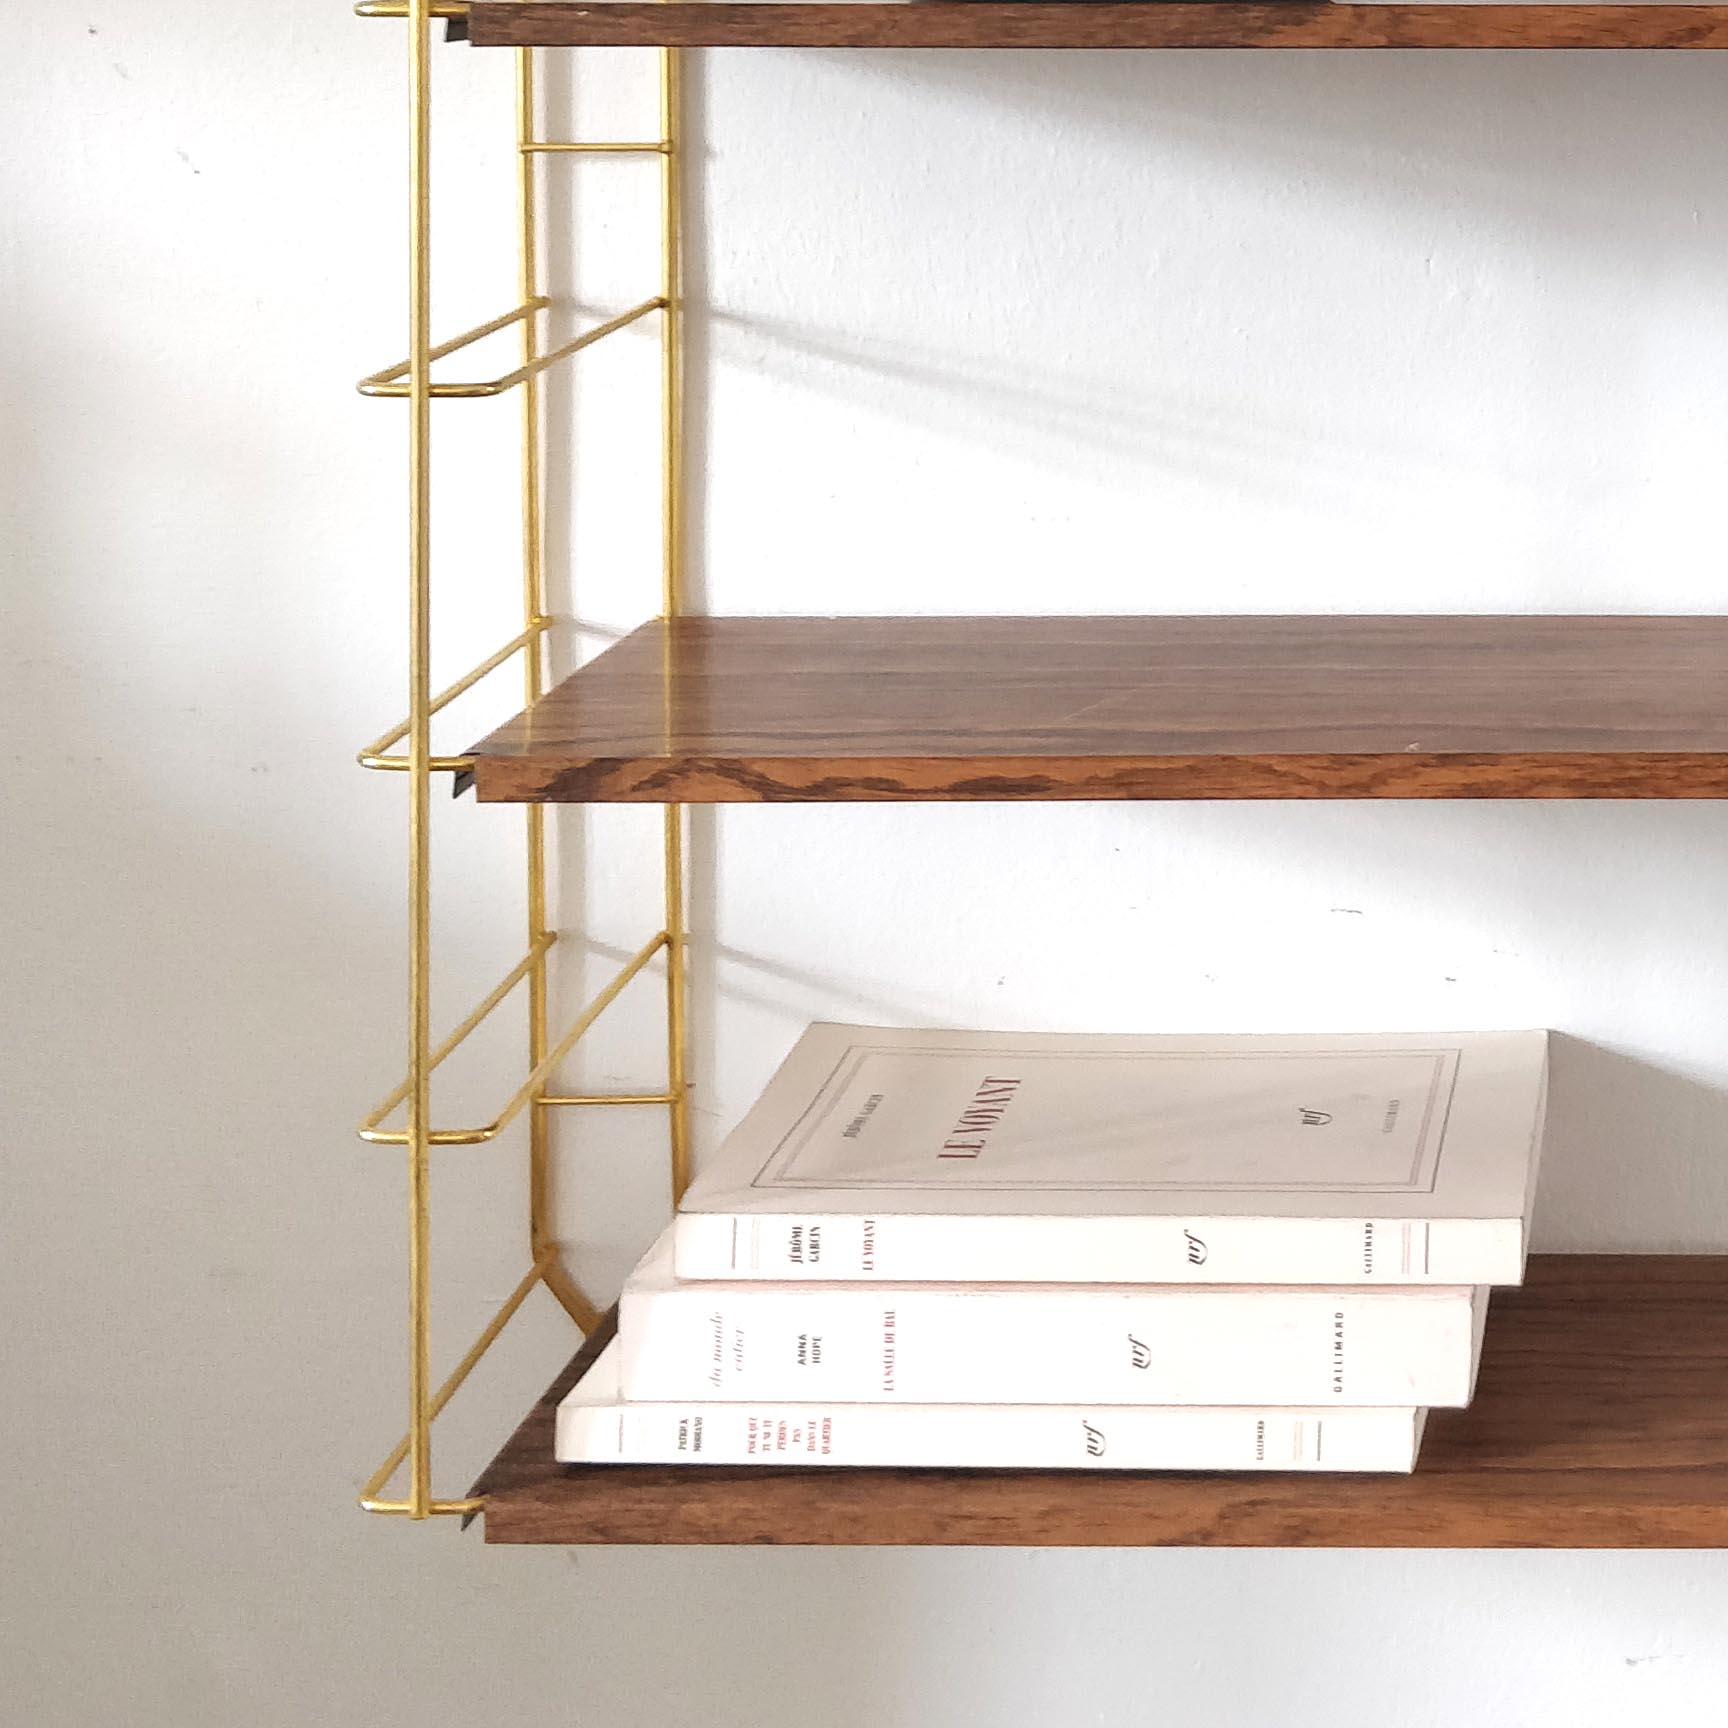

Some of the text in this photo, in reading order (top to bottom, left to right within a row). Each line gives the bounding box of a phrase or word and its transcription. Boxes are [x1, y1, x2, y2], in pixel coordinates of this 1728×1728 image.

[936, 1076, 1021, 1159] LE VOYANT
[1298, 1107, 1331, 1126] nrf
[808, 1226, 821, 1263] GARCIN
[862, 1219, 877, 1255] VOYANT
[1183, 1228, 1206, 1266] nrf
[797, 1333, 808, 1367] ANNA
[1333, 1312, 1344, 1393] GALLIMARD
